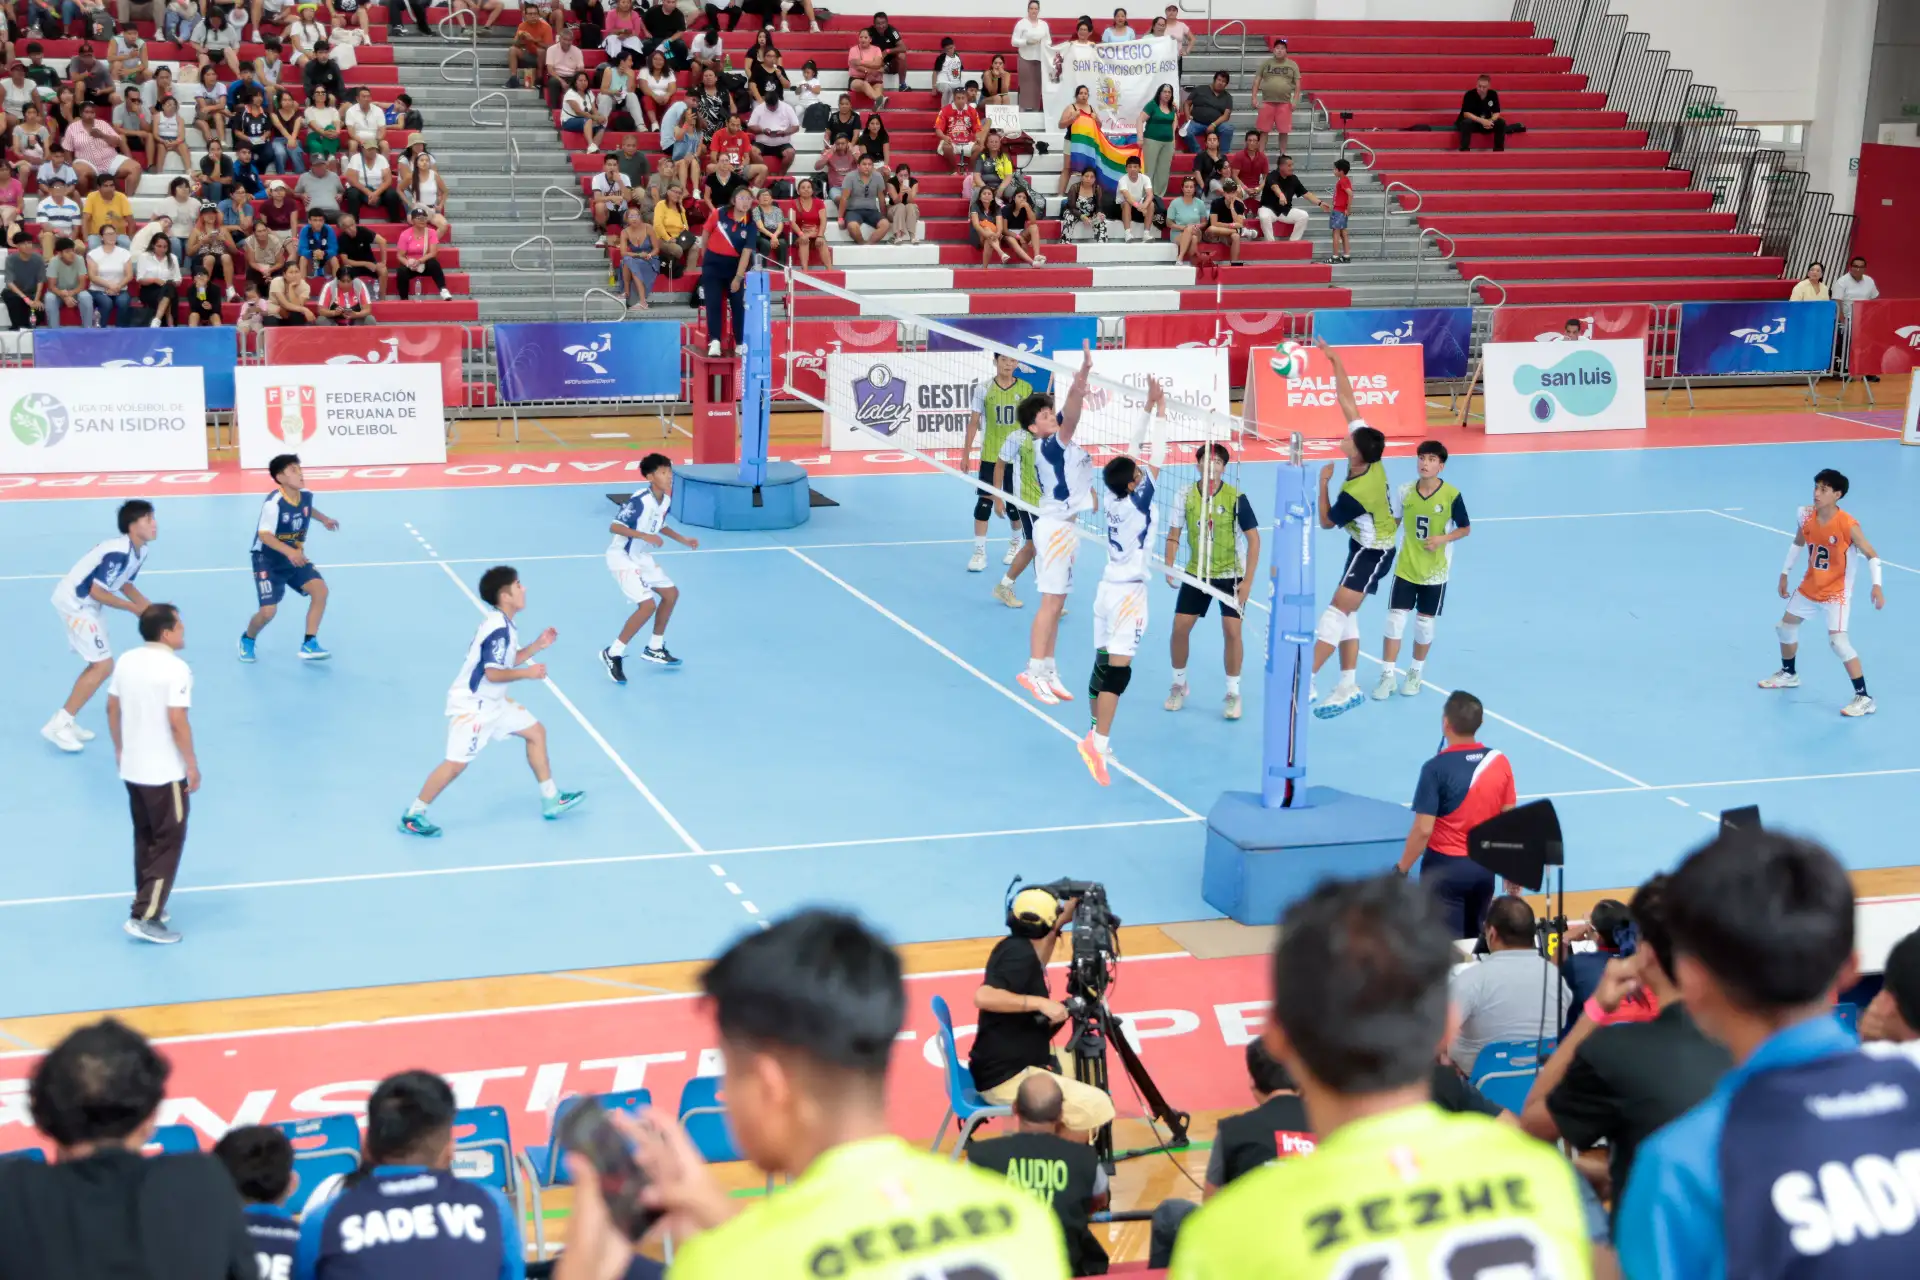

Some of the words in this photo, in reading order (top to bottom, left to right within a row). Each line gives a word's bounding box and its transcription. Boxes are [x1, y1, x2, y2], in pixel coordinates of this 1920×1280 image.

[1097, 43, 1152, 60] COLEGIO
[1073, 60, 1091, 72] SAN
[1093, 60, 1142, 76] FRANCISCO
[1144, 62, 1157, 74] DE
[728, 153, 740, 165] 12
[1744, 333, 1768, 343] IPD
[577, 351, 597, 362] IPD
[796, 357, 824, 367] IPD
[1541, 372, 1575, 387] san
[1579, 367, 1612, 386] luis
[326, 389, 416, 404] FEDERACIÓN
[1287, 390, 1400, 407] FACORY
[72, 404, 97, 413] LIGA
[100, 404, 113, 412] DE
[116, 403, 166, 413] VOLEIBOL
[169, 403, 184, 412] DE
[327, 408, 395, 420] PERUANA
[398, 407, 417, 418] DE
[994, 405, 1016, 425] 10
[75, 418, 114, 433] SAN
[120, 417, 186, 432] ISIDRO
[328, 424, 397, 436] VOLEIBOL
[917, 413, 980, 433] DEPORT
[291, 517, 304, 531] 10
[1416, 515, 1429, 540] 5
[1808, 543, 1830, 570] 12
[258, 580, 273, 594] 10
[94, 635, 105, 650] 6
[1134, 629, 1142, 644] 5
[1006, 1158, 1069, 1191] AUDIO
[339, 1203, 439, 1252] SADE
[437, 1202, 487, 1244] VC
